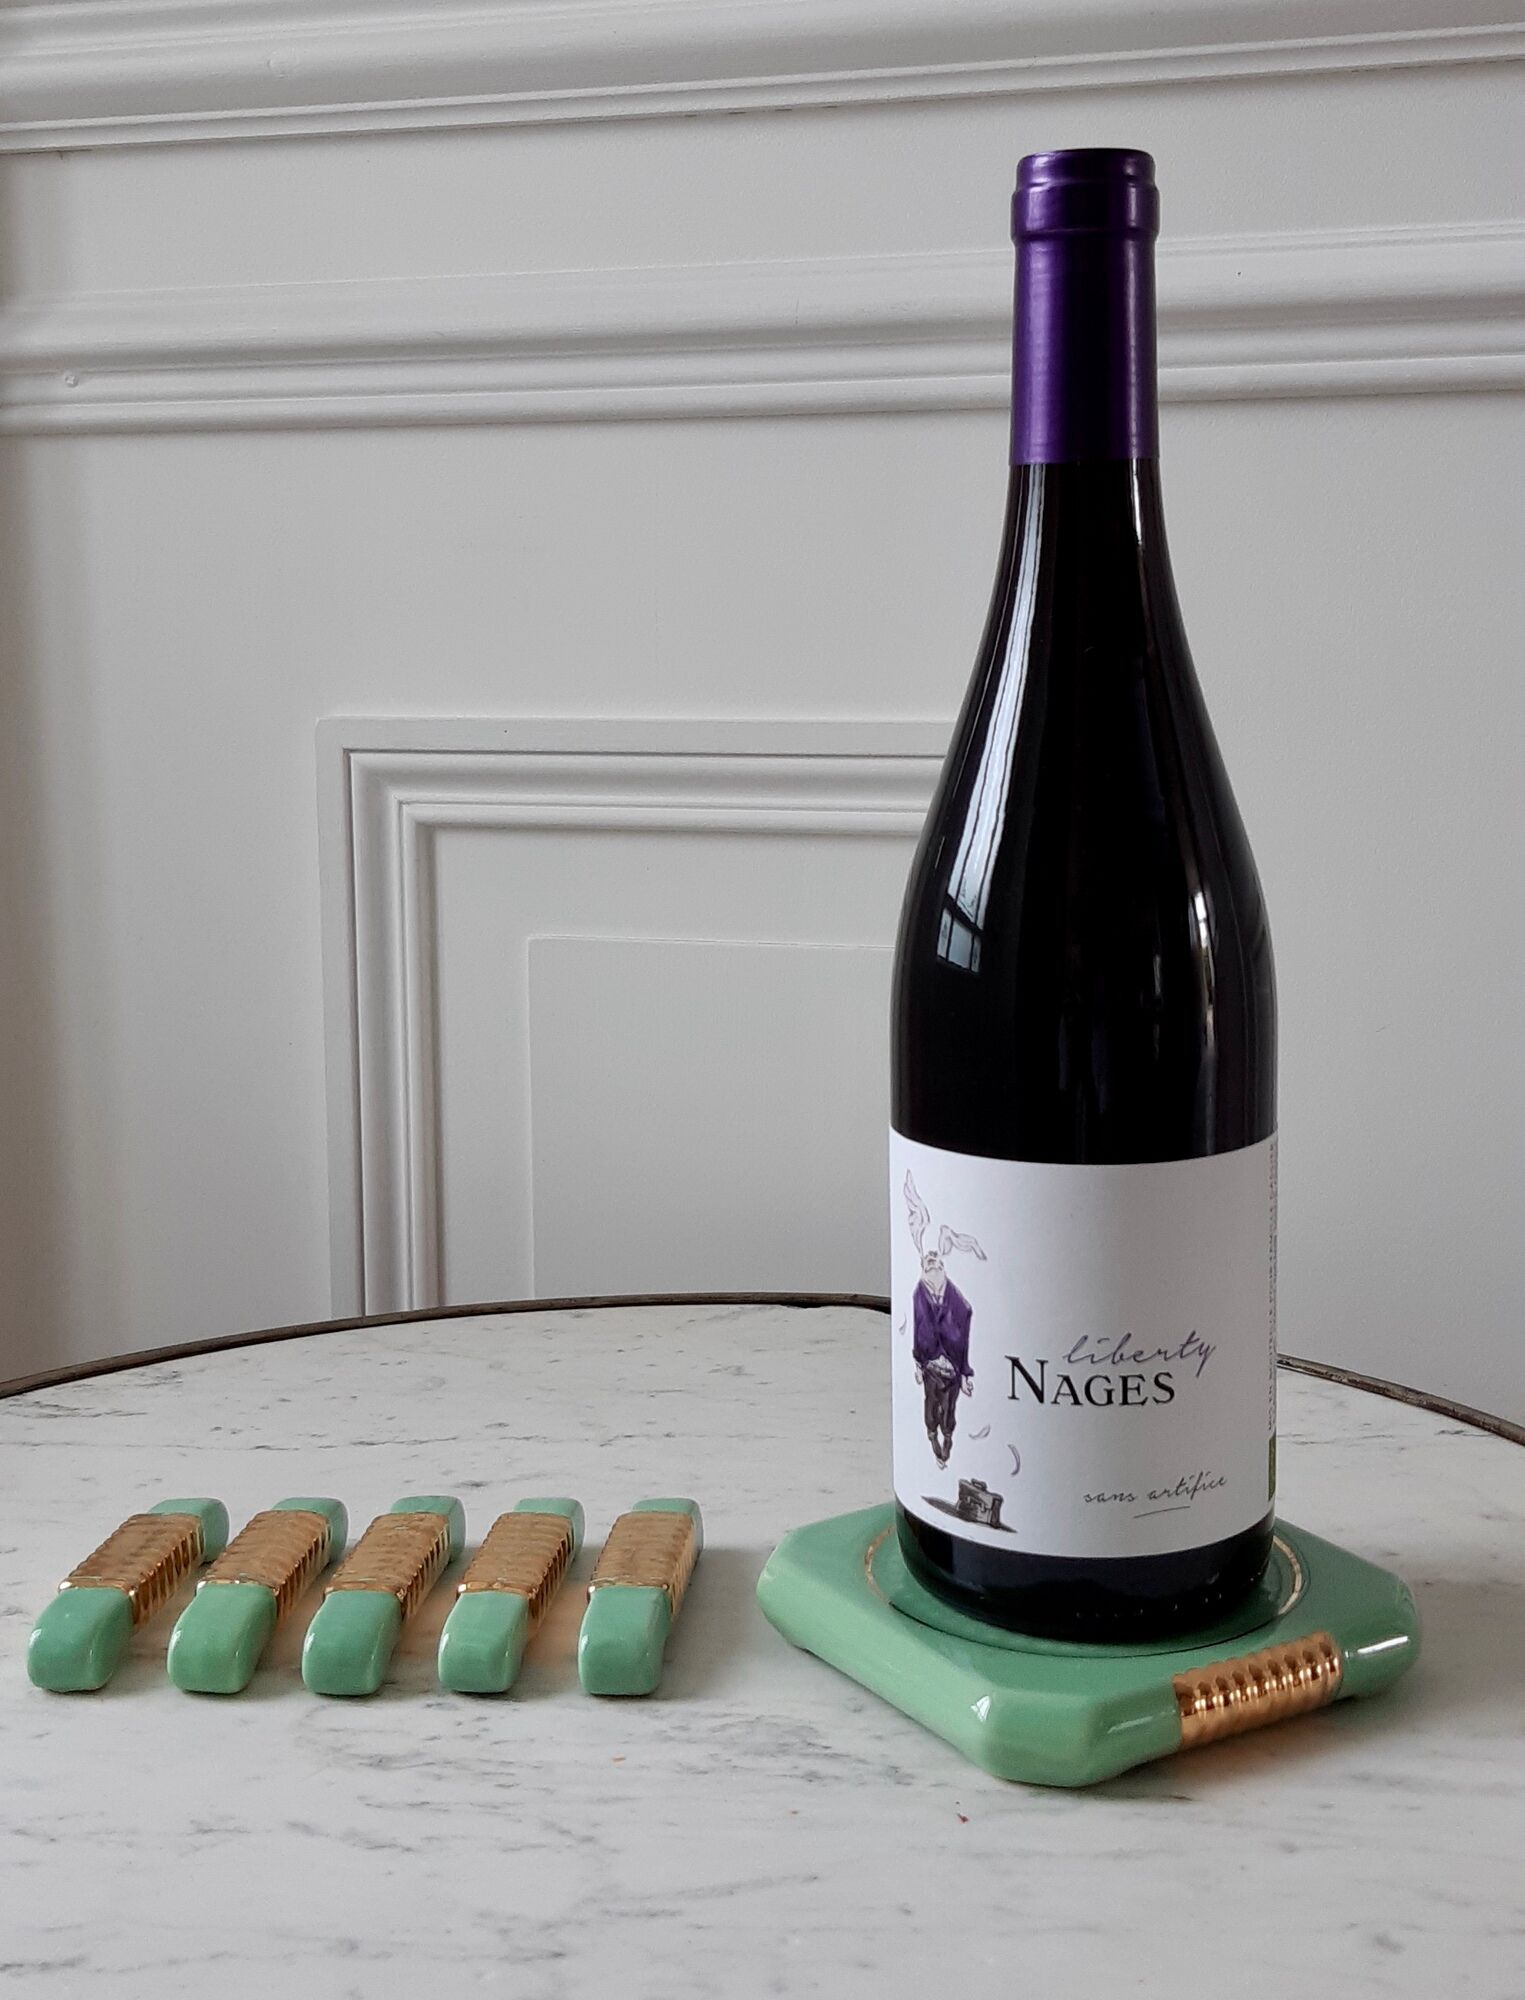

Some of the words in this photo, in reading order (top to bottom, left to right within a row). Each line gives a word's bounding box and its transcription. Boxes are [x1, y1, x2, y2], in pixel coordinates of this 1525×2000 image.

[1063, 1330, 1216, 1377] liberty
[1005, 1355, 1175, 1406] NAGES
[1083, 1491, 1138, 1504] sans
[1148, 1471, 1228, 1500] artifice
